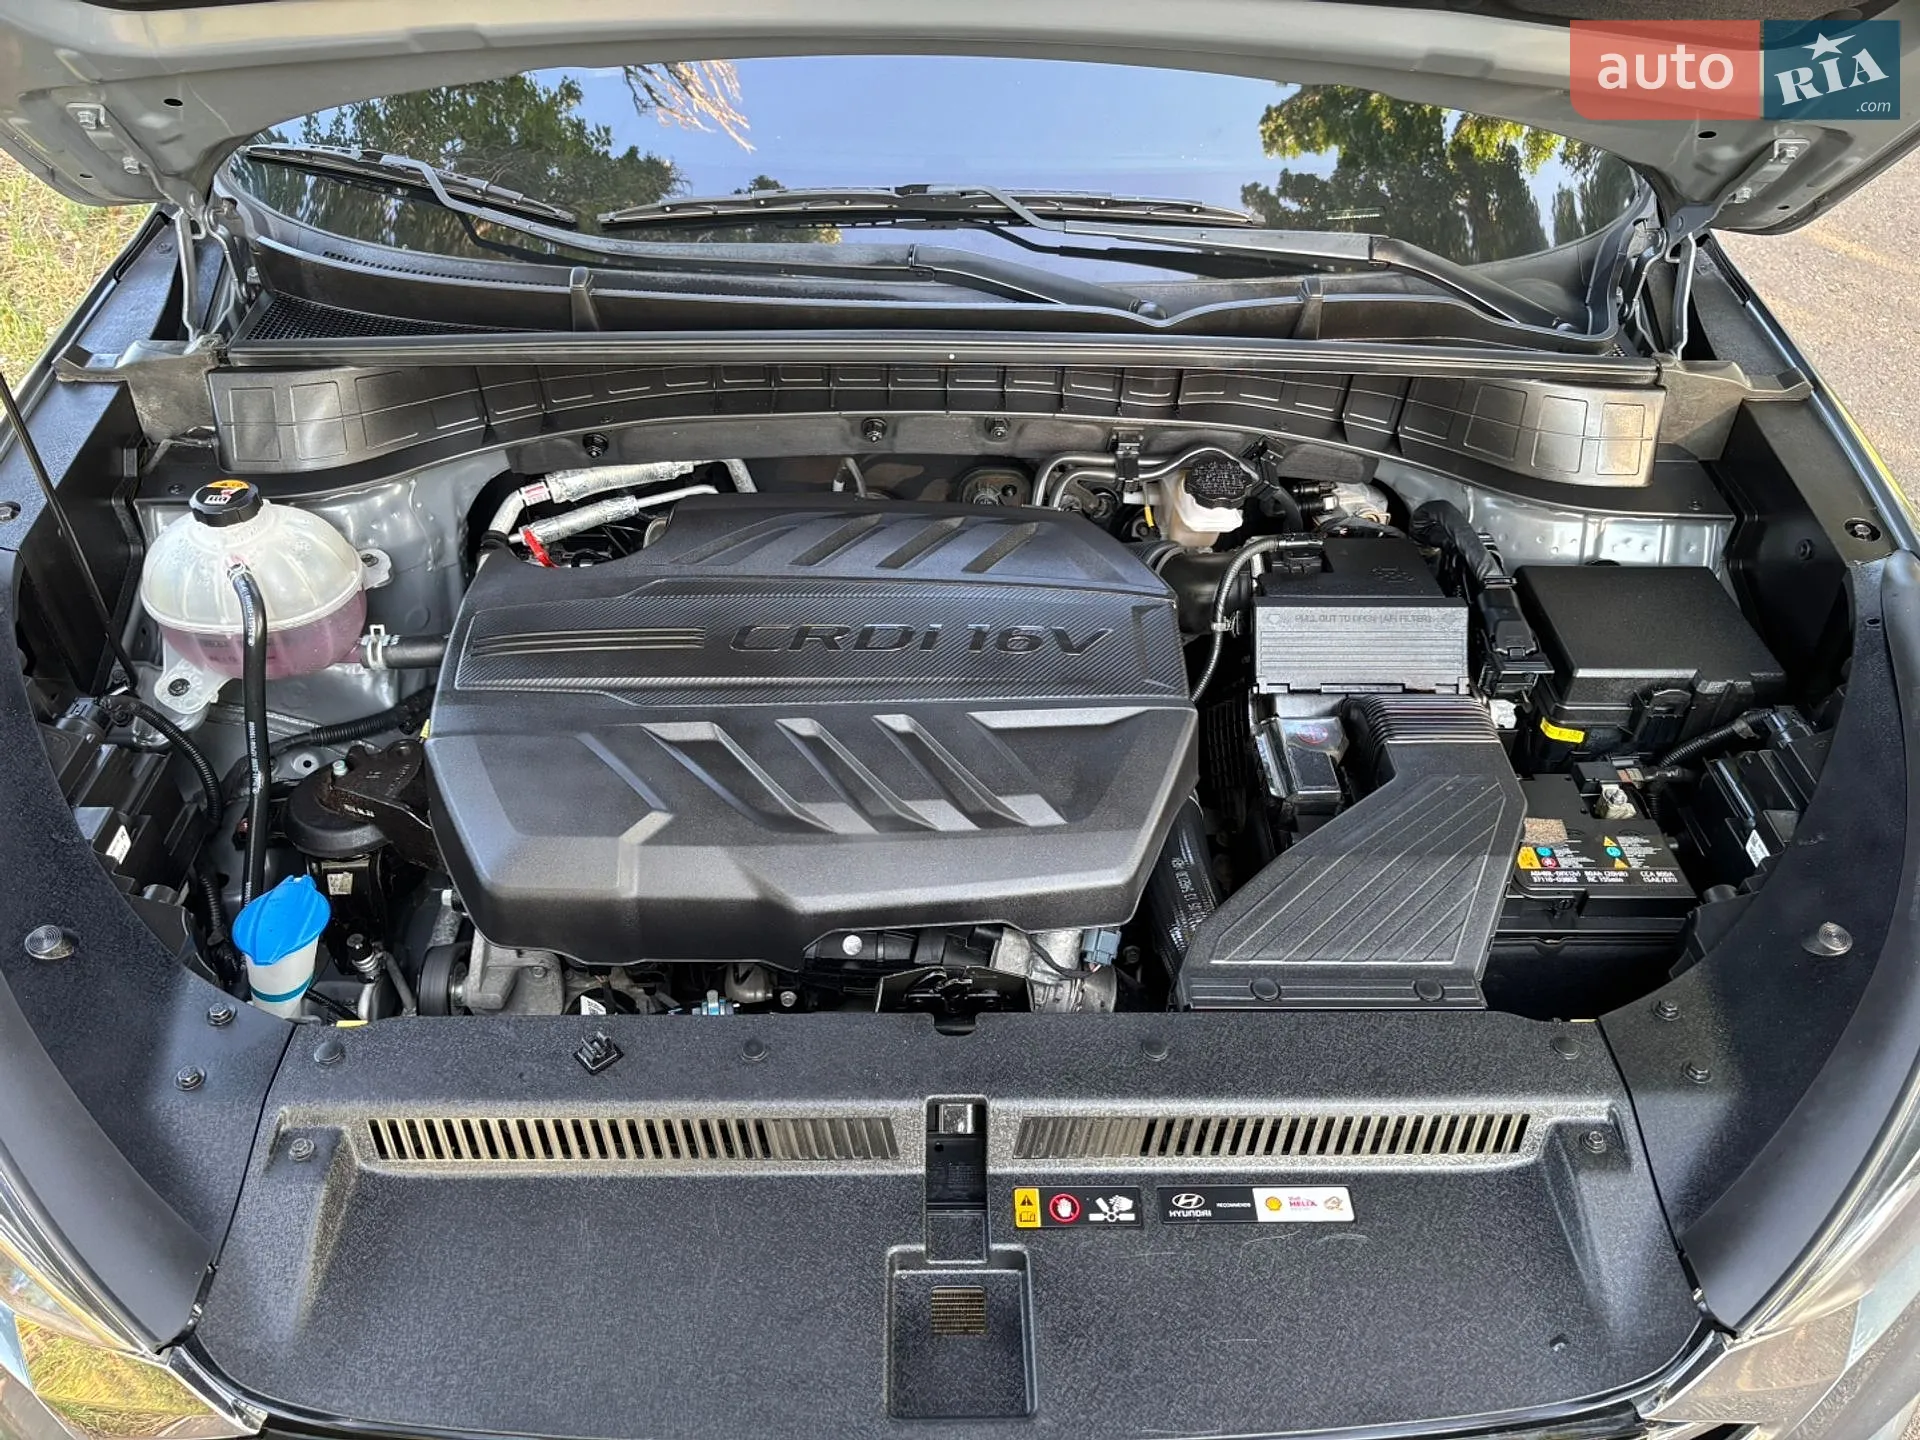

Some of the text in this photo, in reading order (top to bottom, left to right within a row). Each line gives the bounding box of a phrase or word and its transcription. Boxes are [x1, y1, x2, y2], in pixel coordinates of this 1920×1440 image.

[1319, 614, 1336, 623] OUT
[729, 623, 1114, 655] CRDi 16V
[1168, 1209, 1212, 1217] HYUNDAI
